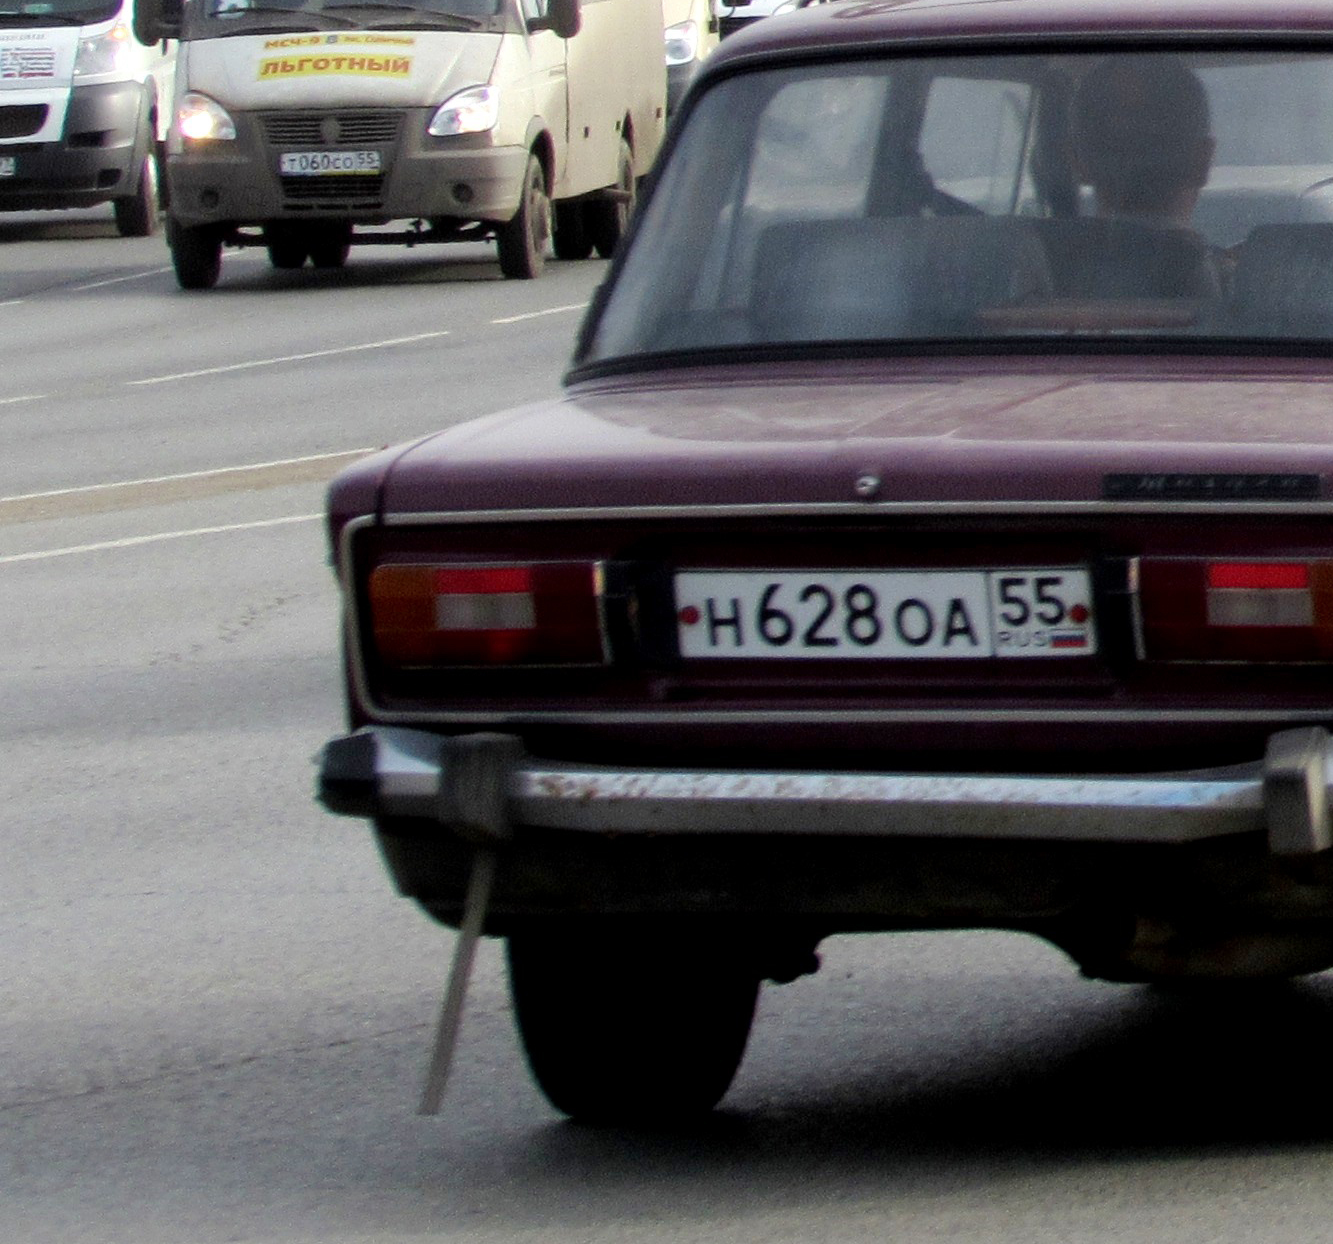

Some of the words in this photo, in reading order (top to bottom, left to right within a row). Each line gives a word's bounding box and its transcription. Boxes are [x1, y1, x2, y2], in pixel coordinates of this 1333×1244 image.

[261, 56, 410, 75] ЛЬГОТНЫЙ
[999, 577, 1066, 627] 55
[999, 631, 1047, 647] RUS
